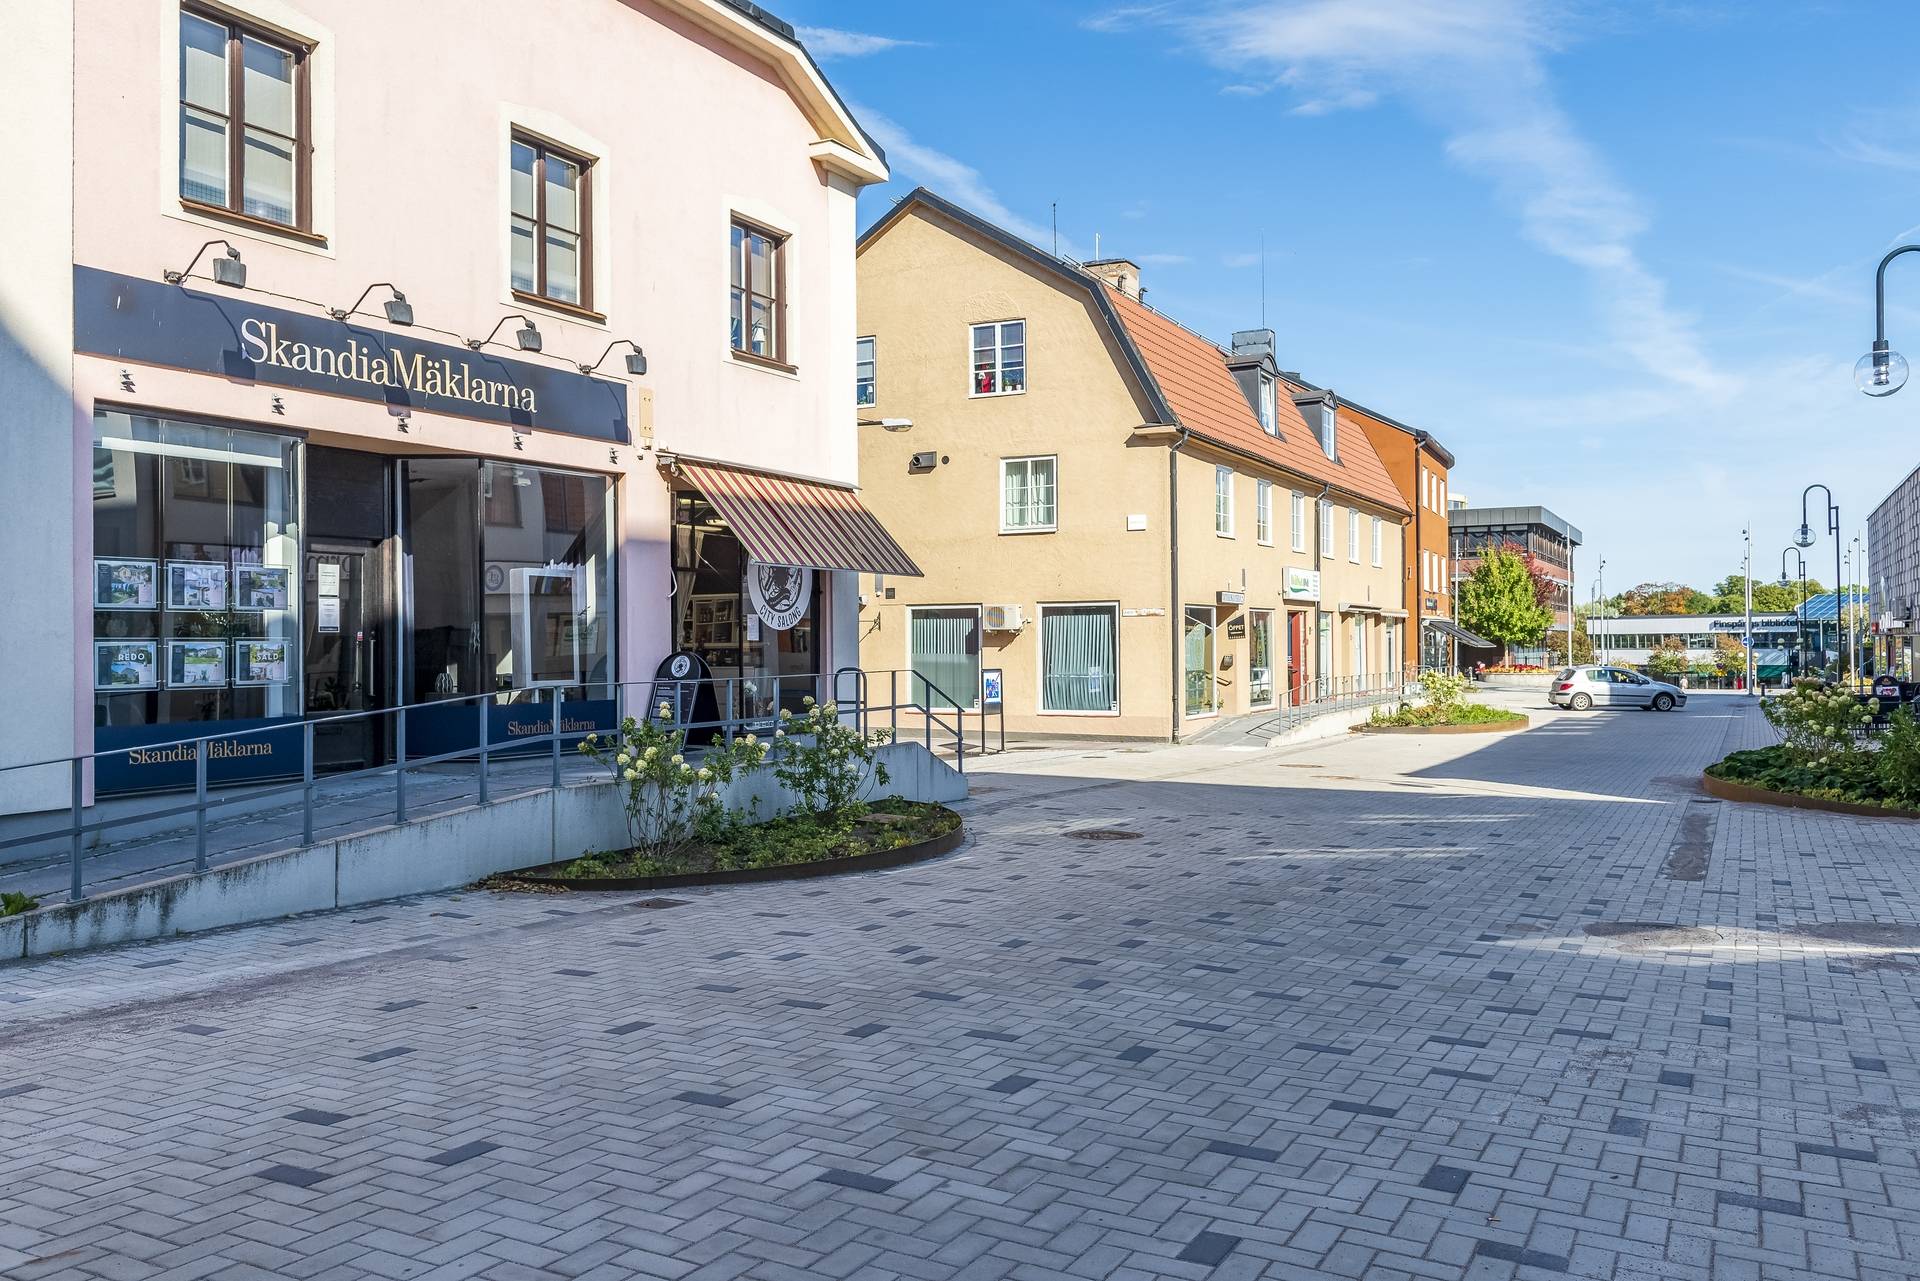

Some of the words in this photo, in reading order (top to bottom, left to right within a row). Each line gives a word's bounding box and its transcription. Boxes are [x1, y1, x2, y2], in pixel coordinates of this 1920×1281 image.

[240, 318, 538, 413] SkandiaMäklarna
[760, 604, 776, 624] CITY
[778, 606, 801, 628] SALONG
